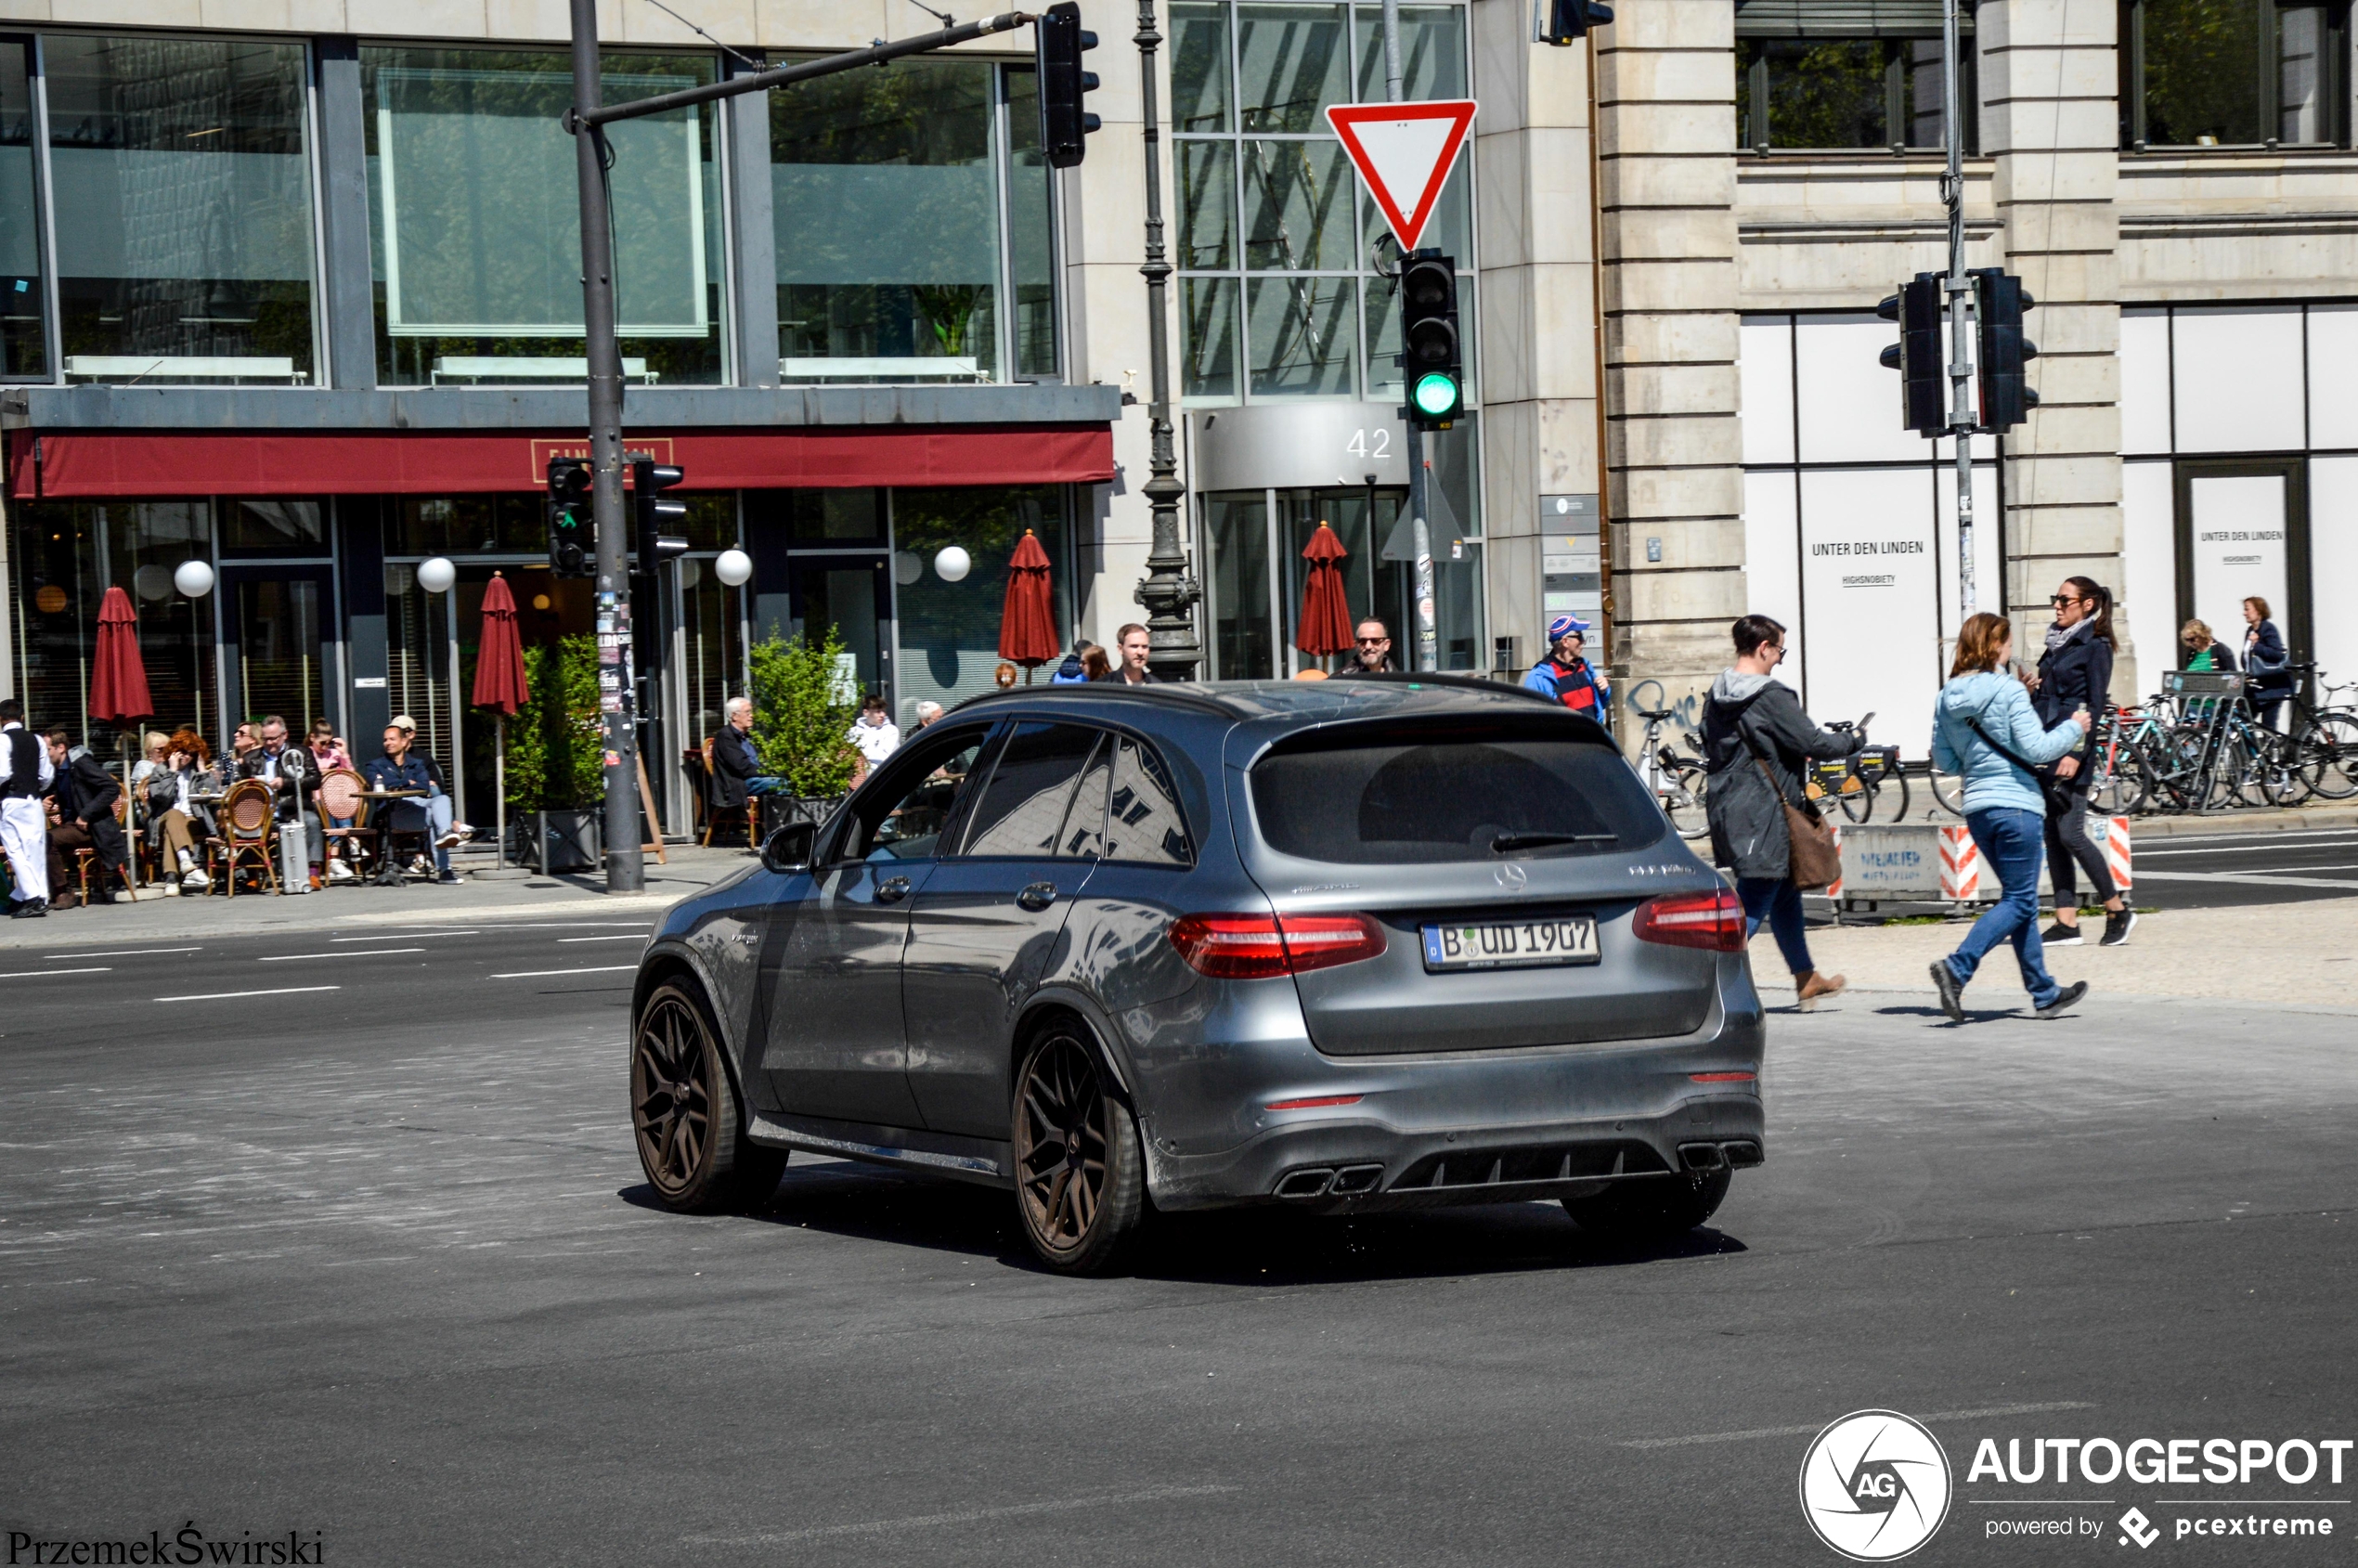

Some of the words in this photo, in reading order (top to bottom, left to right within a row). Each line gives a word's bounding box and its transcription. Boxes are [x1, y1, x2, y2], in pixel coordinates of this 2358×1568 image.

[1346, 428, 1391, 459] 42
[2201, 531, 2229, 541] UNTER
[2232, 531, 2248, 541] DEN
[2251, 530, 2283, 540] LINDEN
[1812, 543, 1851, 556] UNTER
[1854, 542, 1877, 555] DEN
[1881, 541, 1924, 554] LINDEN
[1842, 575, 1896, 585] HIGHSNOBIETY
[1443, 926, 1461, 957] B
[1479, 923, 1518, 954] UD
[1523, 920, 1590, 953] 1907
[1430, 947, 1437, 956] D
